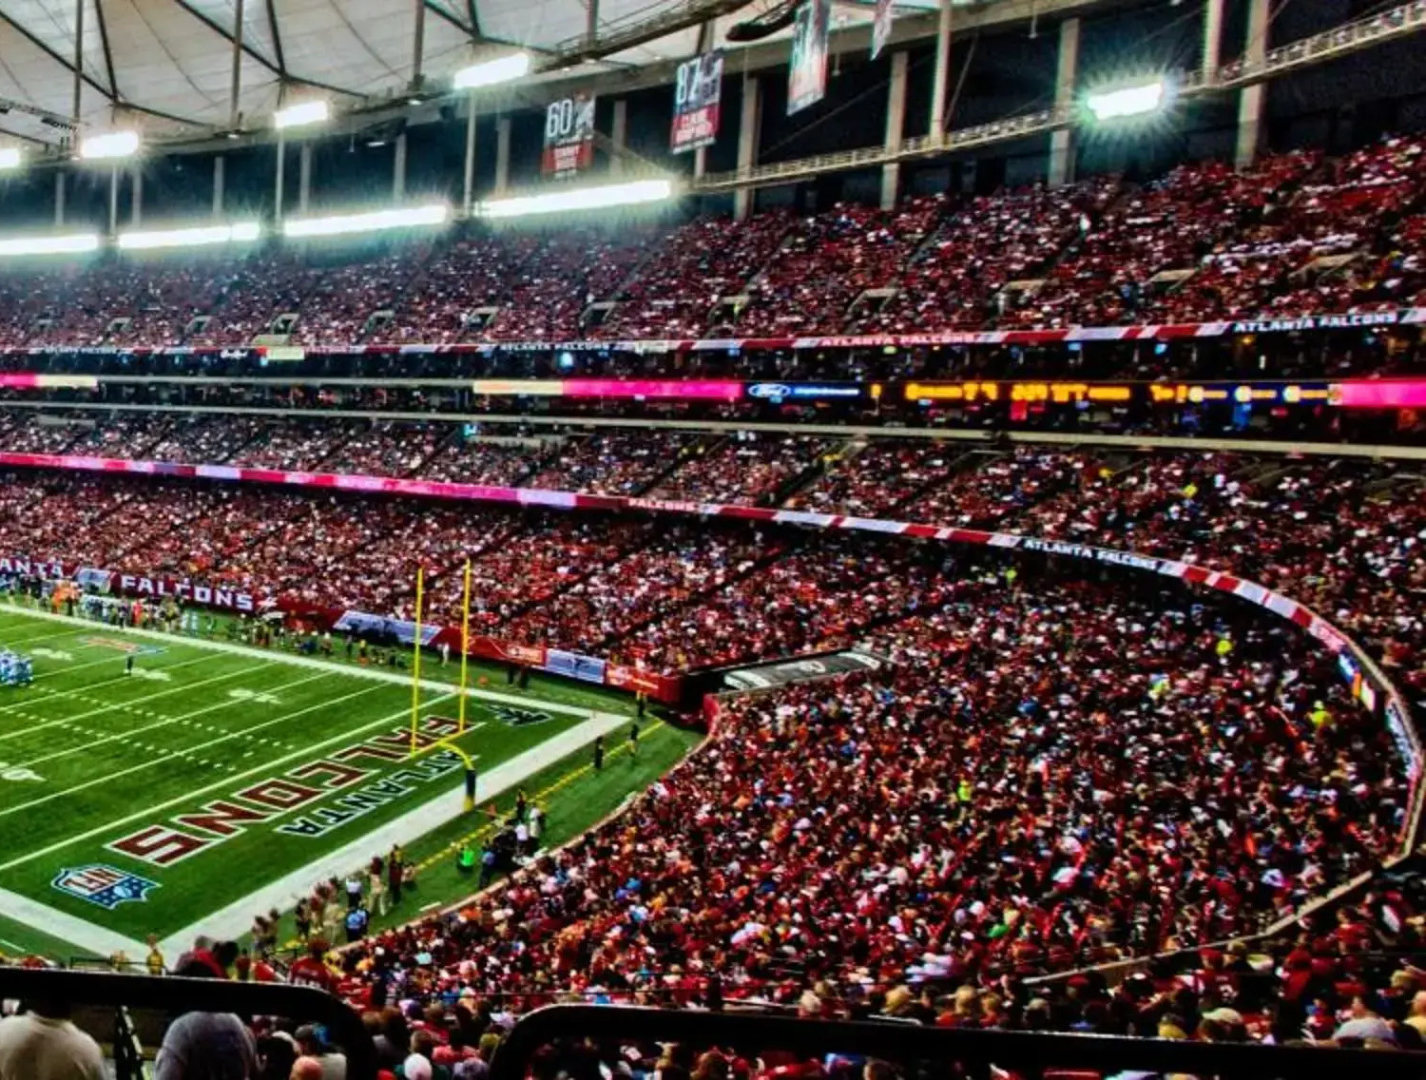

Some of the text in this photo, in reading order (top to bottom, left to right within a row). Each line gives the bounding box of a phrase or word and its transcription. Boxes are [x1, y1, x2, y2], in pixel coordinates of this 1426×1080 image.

[547, 99, 573, 138] 60
[1234, 312, 1397, 333] ATLANTA FALCONS
[500, 342, 551, 351] ATLANTA
[822, 336, 894, 346] ATLANTA
[1024, 539, 1093, 558] ATLANTA
[121, 575, 254, 611] FALCONS
[102, 714, 486, 868] FALCONS
[273, 749, 480, 838] ATLANTA
